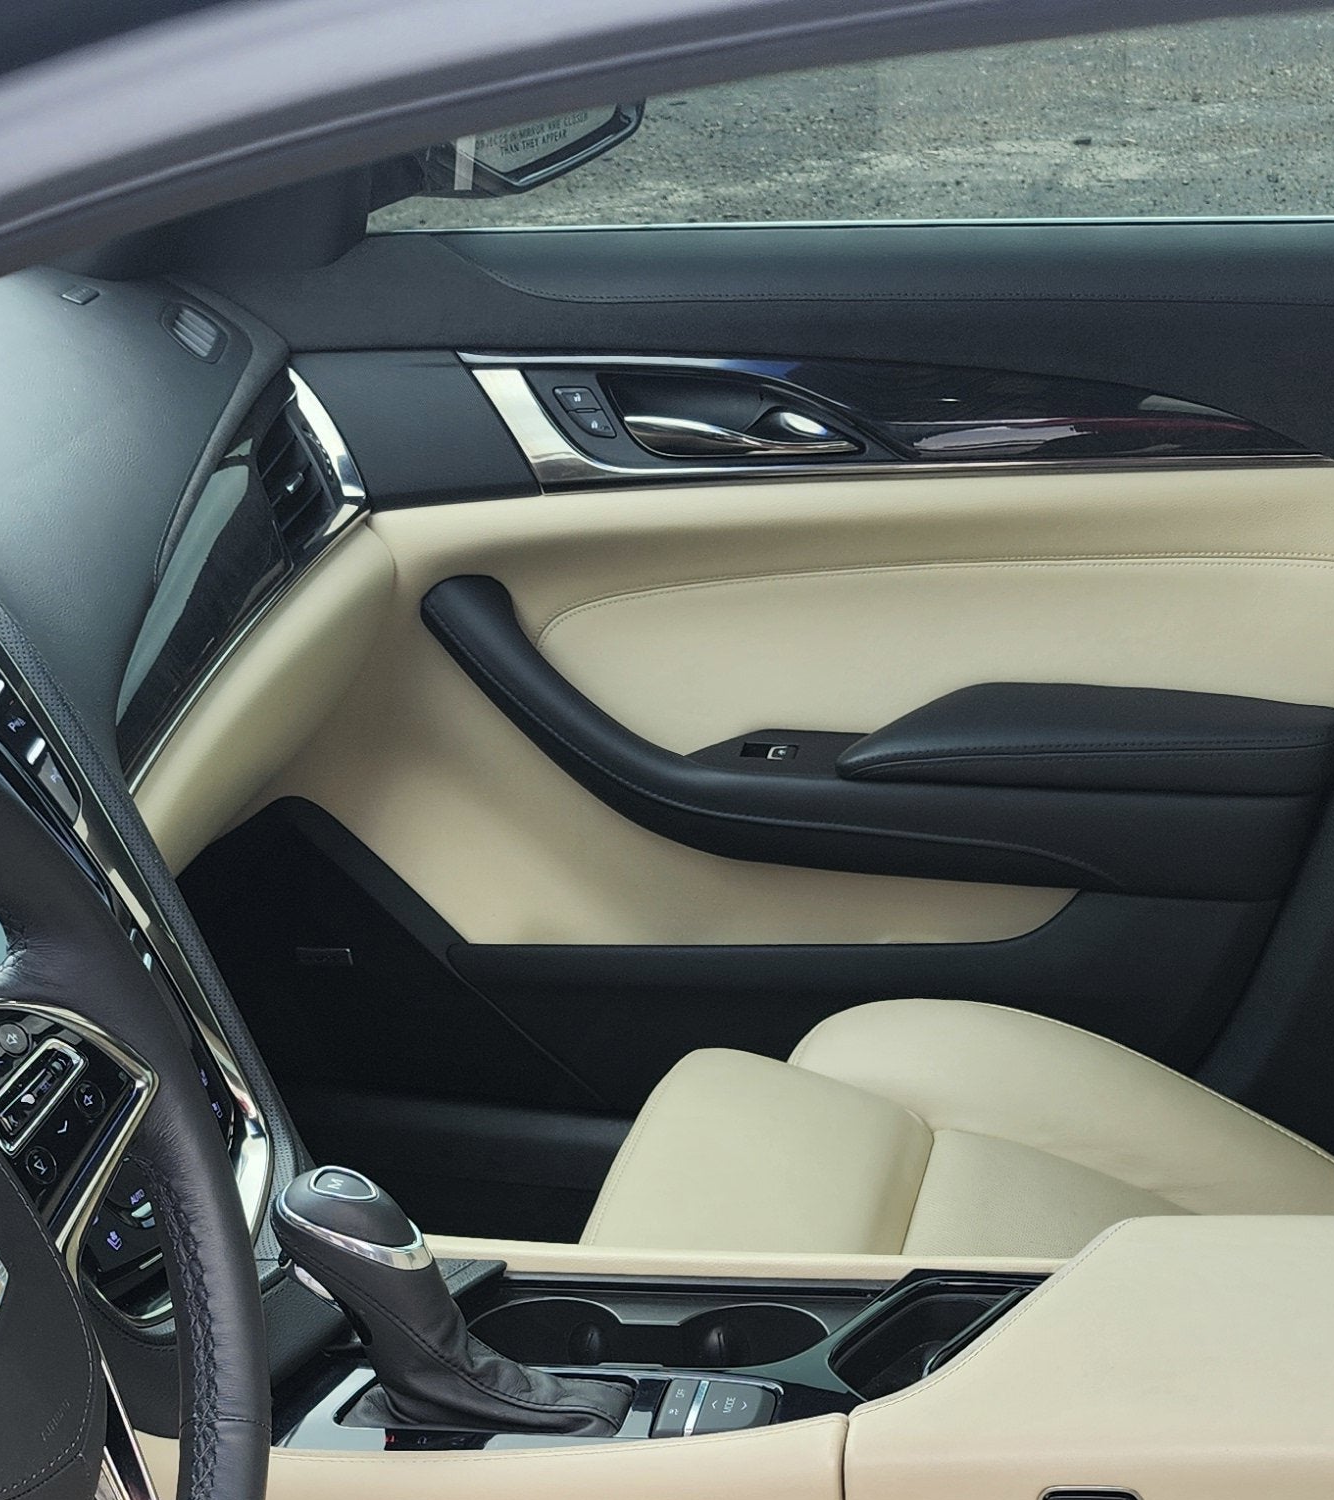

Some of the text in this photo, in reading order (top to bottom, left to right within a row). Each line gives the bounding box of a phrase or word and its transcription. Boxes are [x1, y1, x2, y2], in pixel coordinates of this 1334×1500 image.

[519, 122, 545, 138] MIRROR
[522, 137, 539, 150] THEY
[541, 129, 567, 144] APPEAR
[327, 1178, 344, 1190] M
[722, 1396, 736, 1413] MODE
